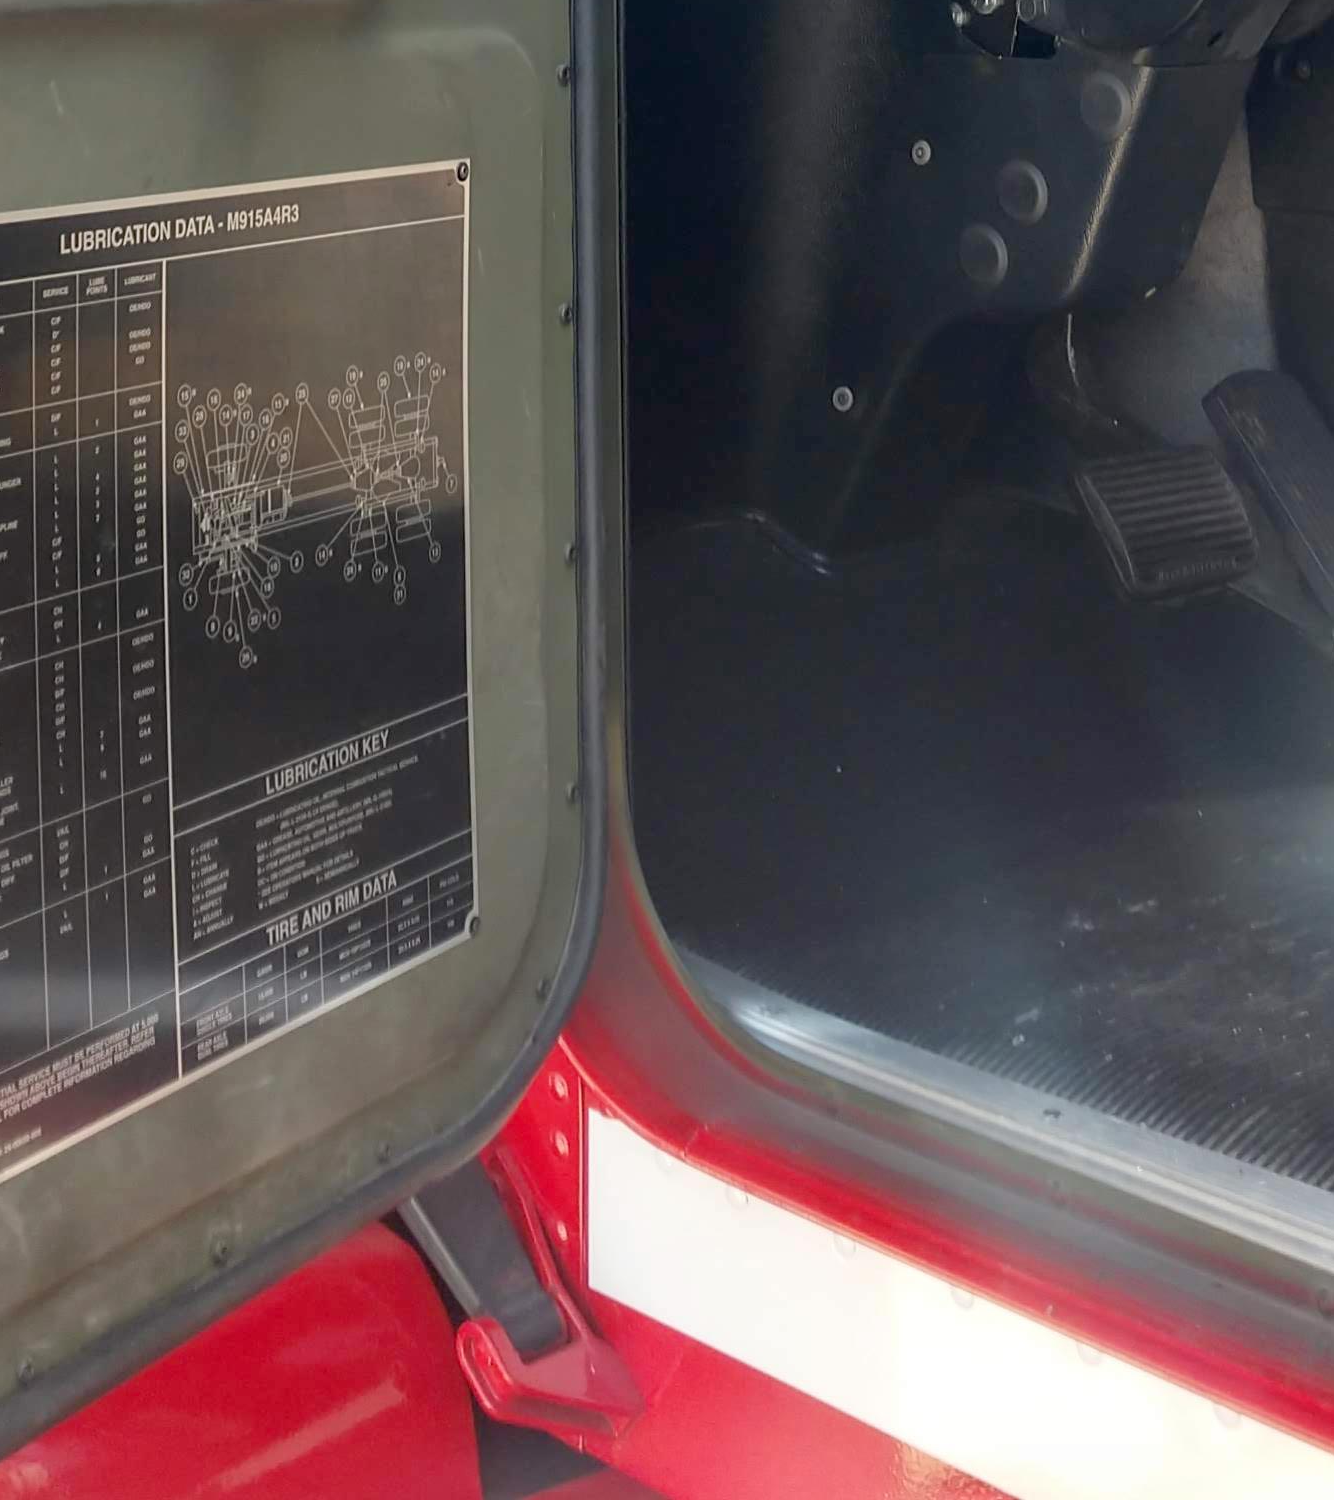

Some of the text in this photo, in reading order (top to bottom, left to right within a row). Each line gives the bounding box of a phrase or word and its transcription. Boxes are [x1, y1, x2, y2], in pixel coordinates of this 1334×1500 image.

[59, 219, 172, 256] LUBRICATION
[174, 213, 215, 240] DATA
[226, 203, 300, 232] M915A4R3
[265, 727, 389, 796] LUBRICATION KEY
[264, 868, 397, 947] TIRE AND RIM DATA
